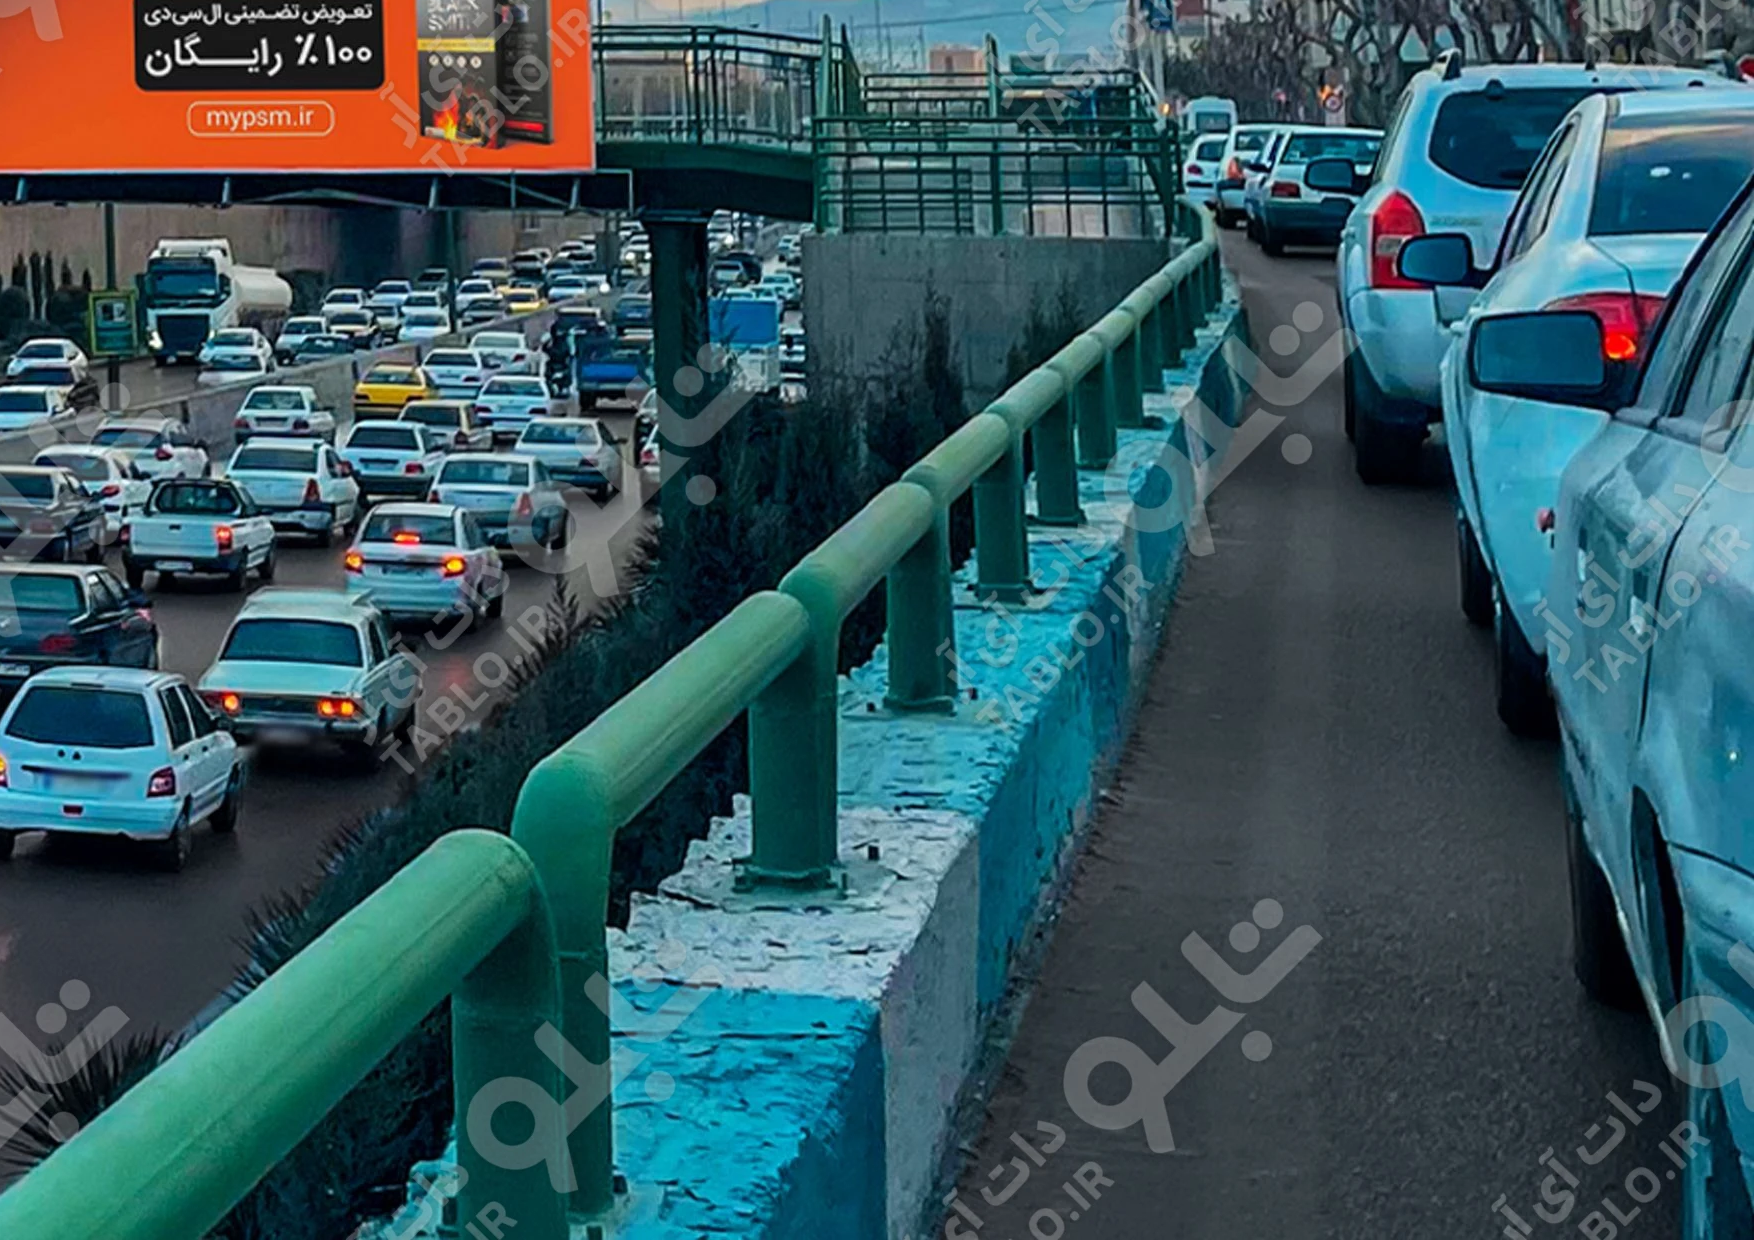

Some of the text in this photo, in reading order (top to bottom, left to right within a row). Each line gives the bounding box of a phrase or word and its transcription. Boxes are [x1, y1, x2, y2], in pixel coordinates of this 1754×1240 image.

[223, 2, 301, 26] تضمینی
[301, 3, 374, 26] تعویض
[144, 32, 284, 78] رایگان
[205, 106, 315, 132] mypsm.ir
